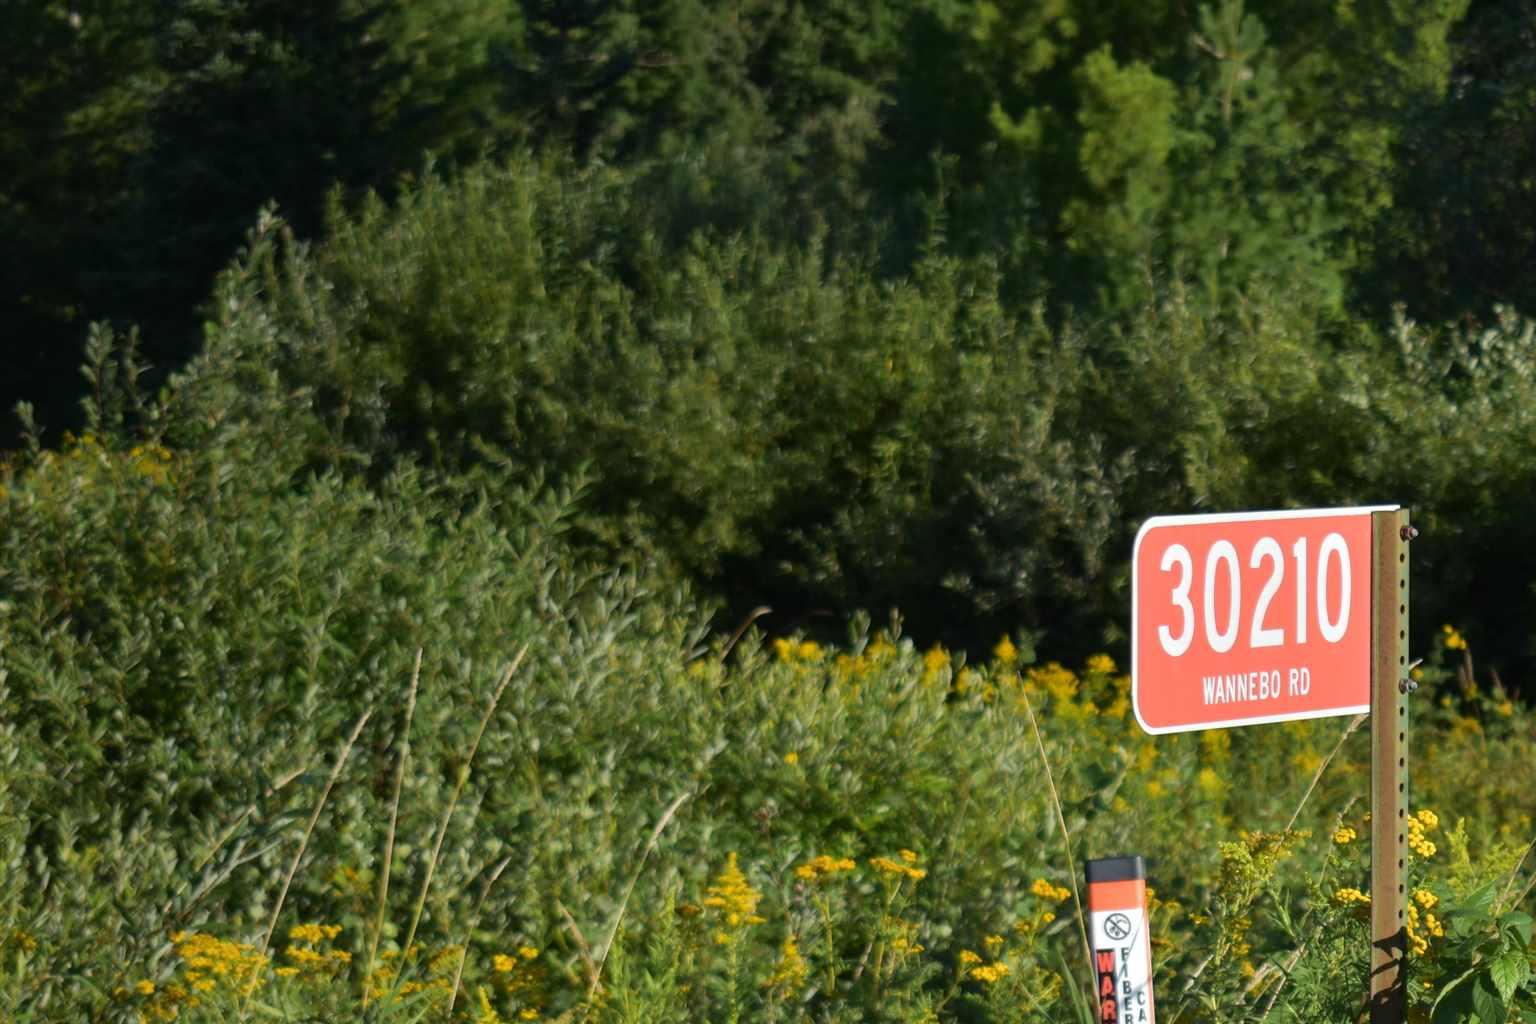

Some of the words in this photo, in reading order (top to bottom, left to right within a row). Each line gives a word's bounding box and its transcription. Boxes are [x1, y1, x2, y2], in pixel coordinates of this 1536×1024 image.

[1157, 532, 1352, 657] 30210
[1203, 672, 1281, 705] WANNEBO
[1289, 668, 1311, 696] RD
